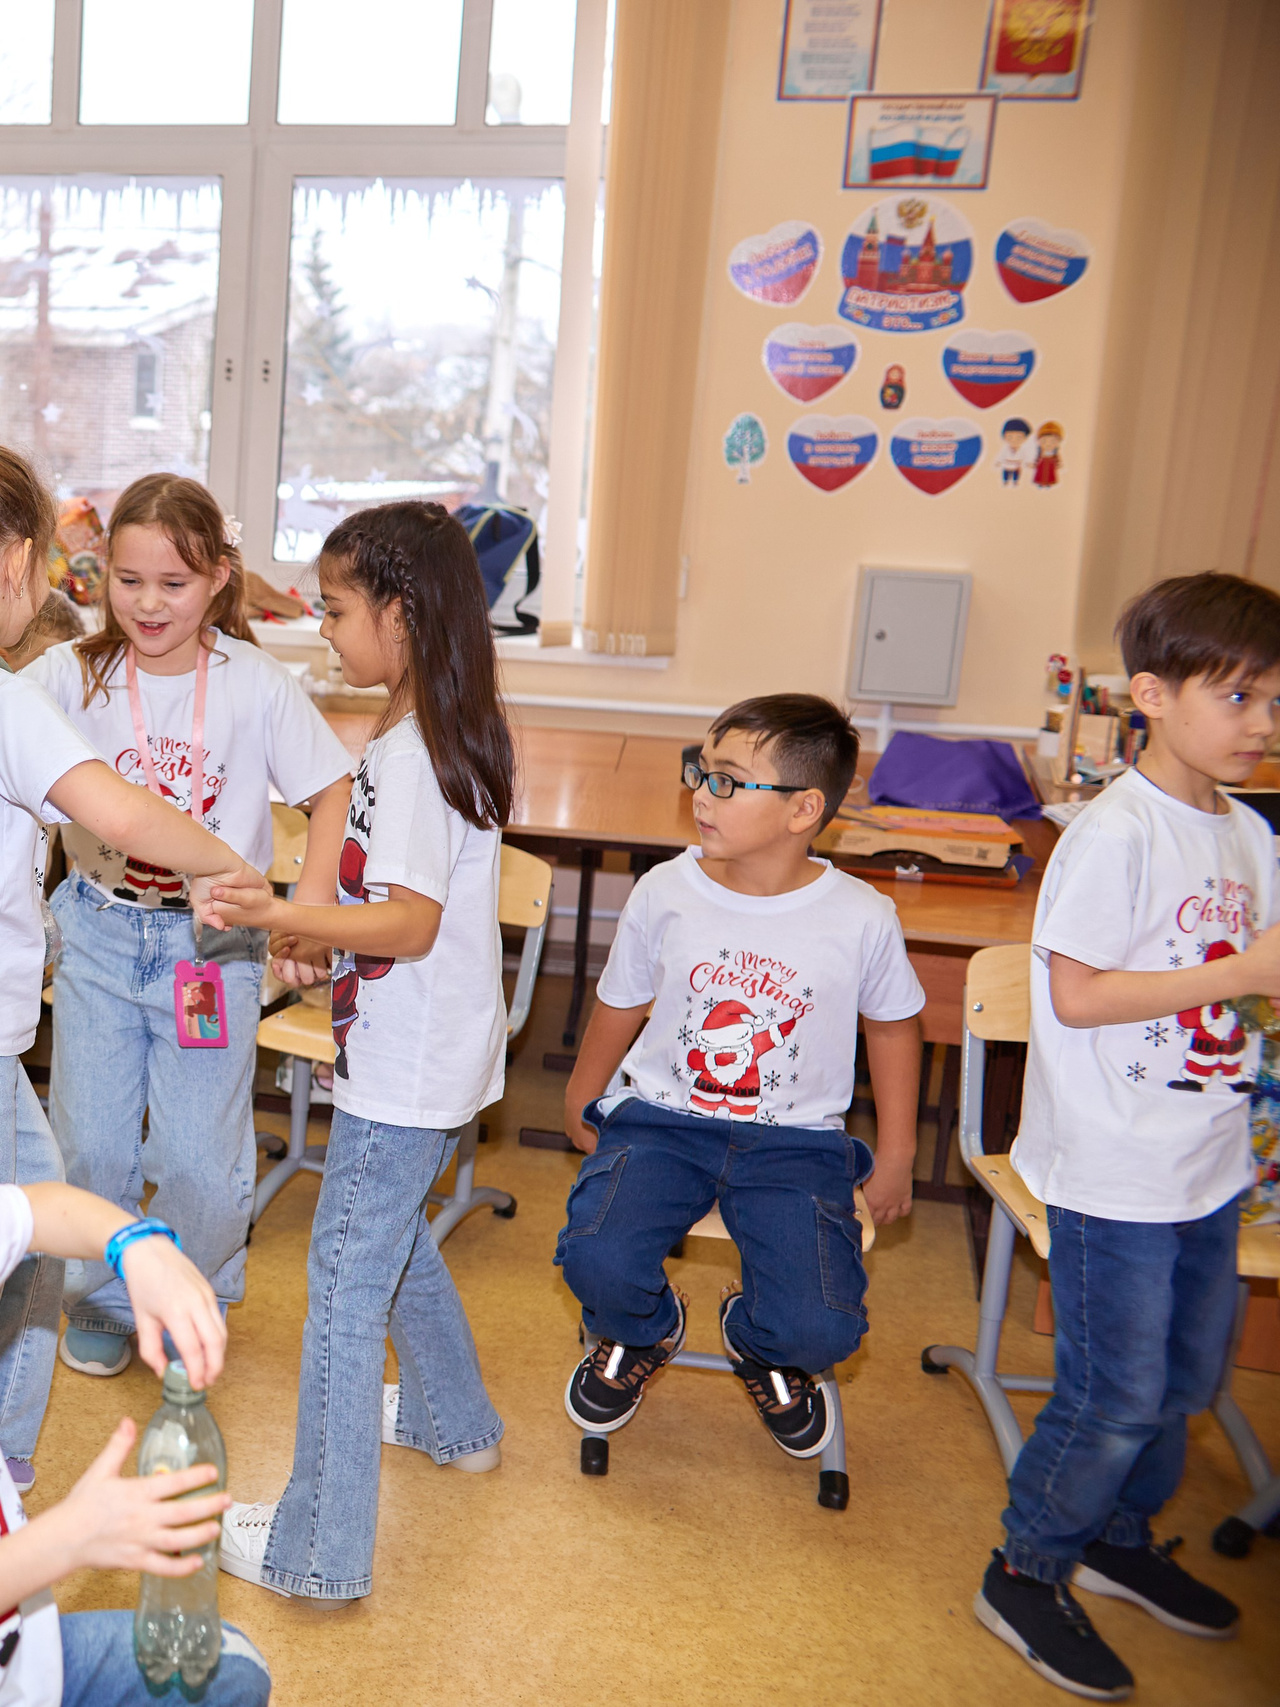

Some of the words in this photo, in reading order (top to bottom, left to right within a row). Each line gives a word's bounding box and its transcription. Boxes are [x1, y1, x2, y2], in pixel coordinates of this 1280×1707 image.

[154, 736, 210, 762] Mery
[734, 950, 798, 984] Merry
[689, 962, 815, 1019] Christmas
